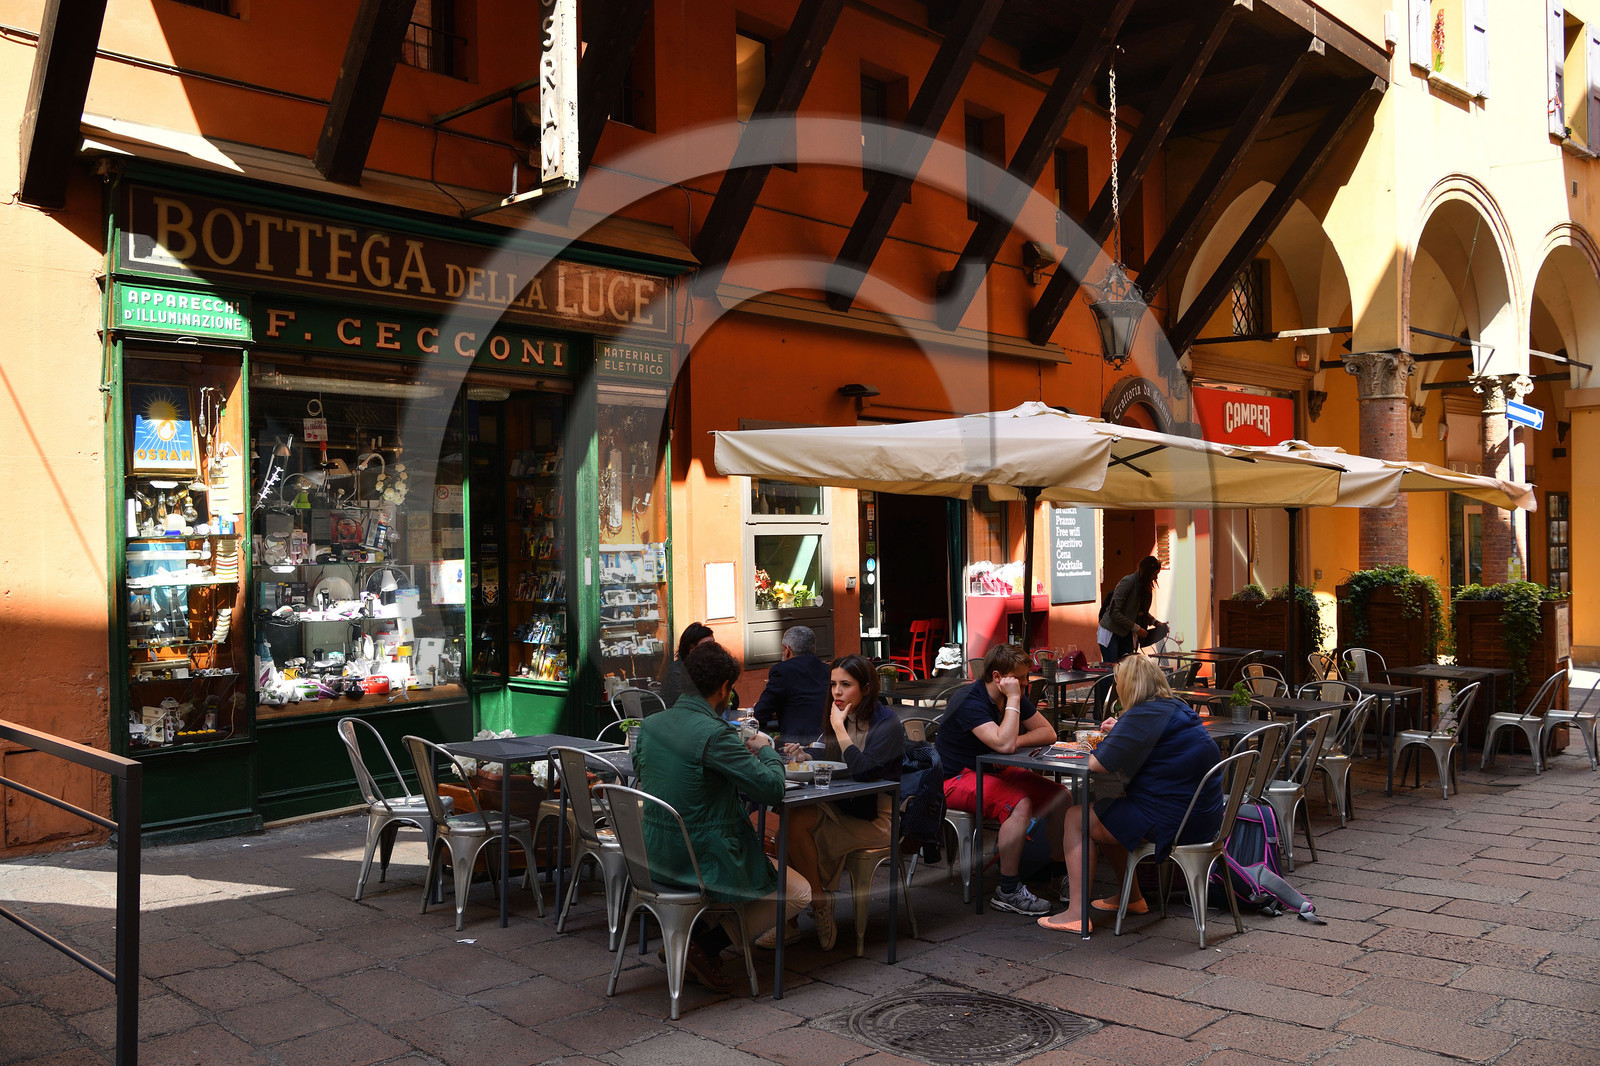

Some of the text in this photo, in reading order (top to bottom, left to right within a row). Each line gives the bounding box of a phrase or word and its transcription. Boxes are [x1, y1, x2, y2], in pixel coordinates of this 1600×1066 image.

[152, 196, 654, 325] BOTTEGA DELLA LUCE
[128, 290, 240, 314] APPARECCHI
[124, 308, 243, 331] D'ILLUMINAZIONE
[266, 308, 563, 367] F. CECCONI
[604, 347, 664, 363] MATERIALE
[604, 360, 664, 375] ELETTRICO
[1224, 401, 1271, 437] CAMPER
[137, 449, 192, 461] OSRAM
[1055, 515, 1076, 525] Pranzo
[1056, 527, 1081, 537] Free wifi
[1056, 538, 1082, 550] Aperitivo
[1056, 549, 1071, 559] Cena
[1056, 560, 1083, 570] Cocktails
